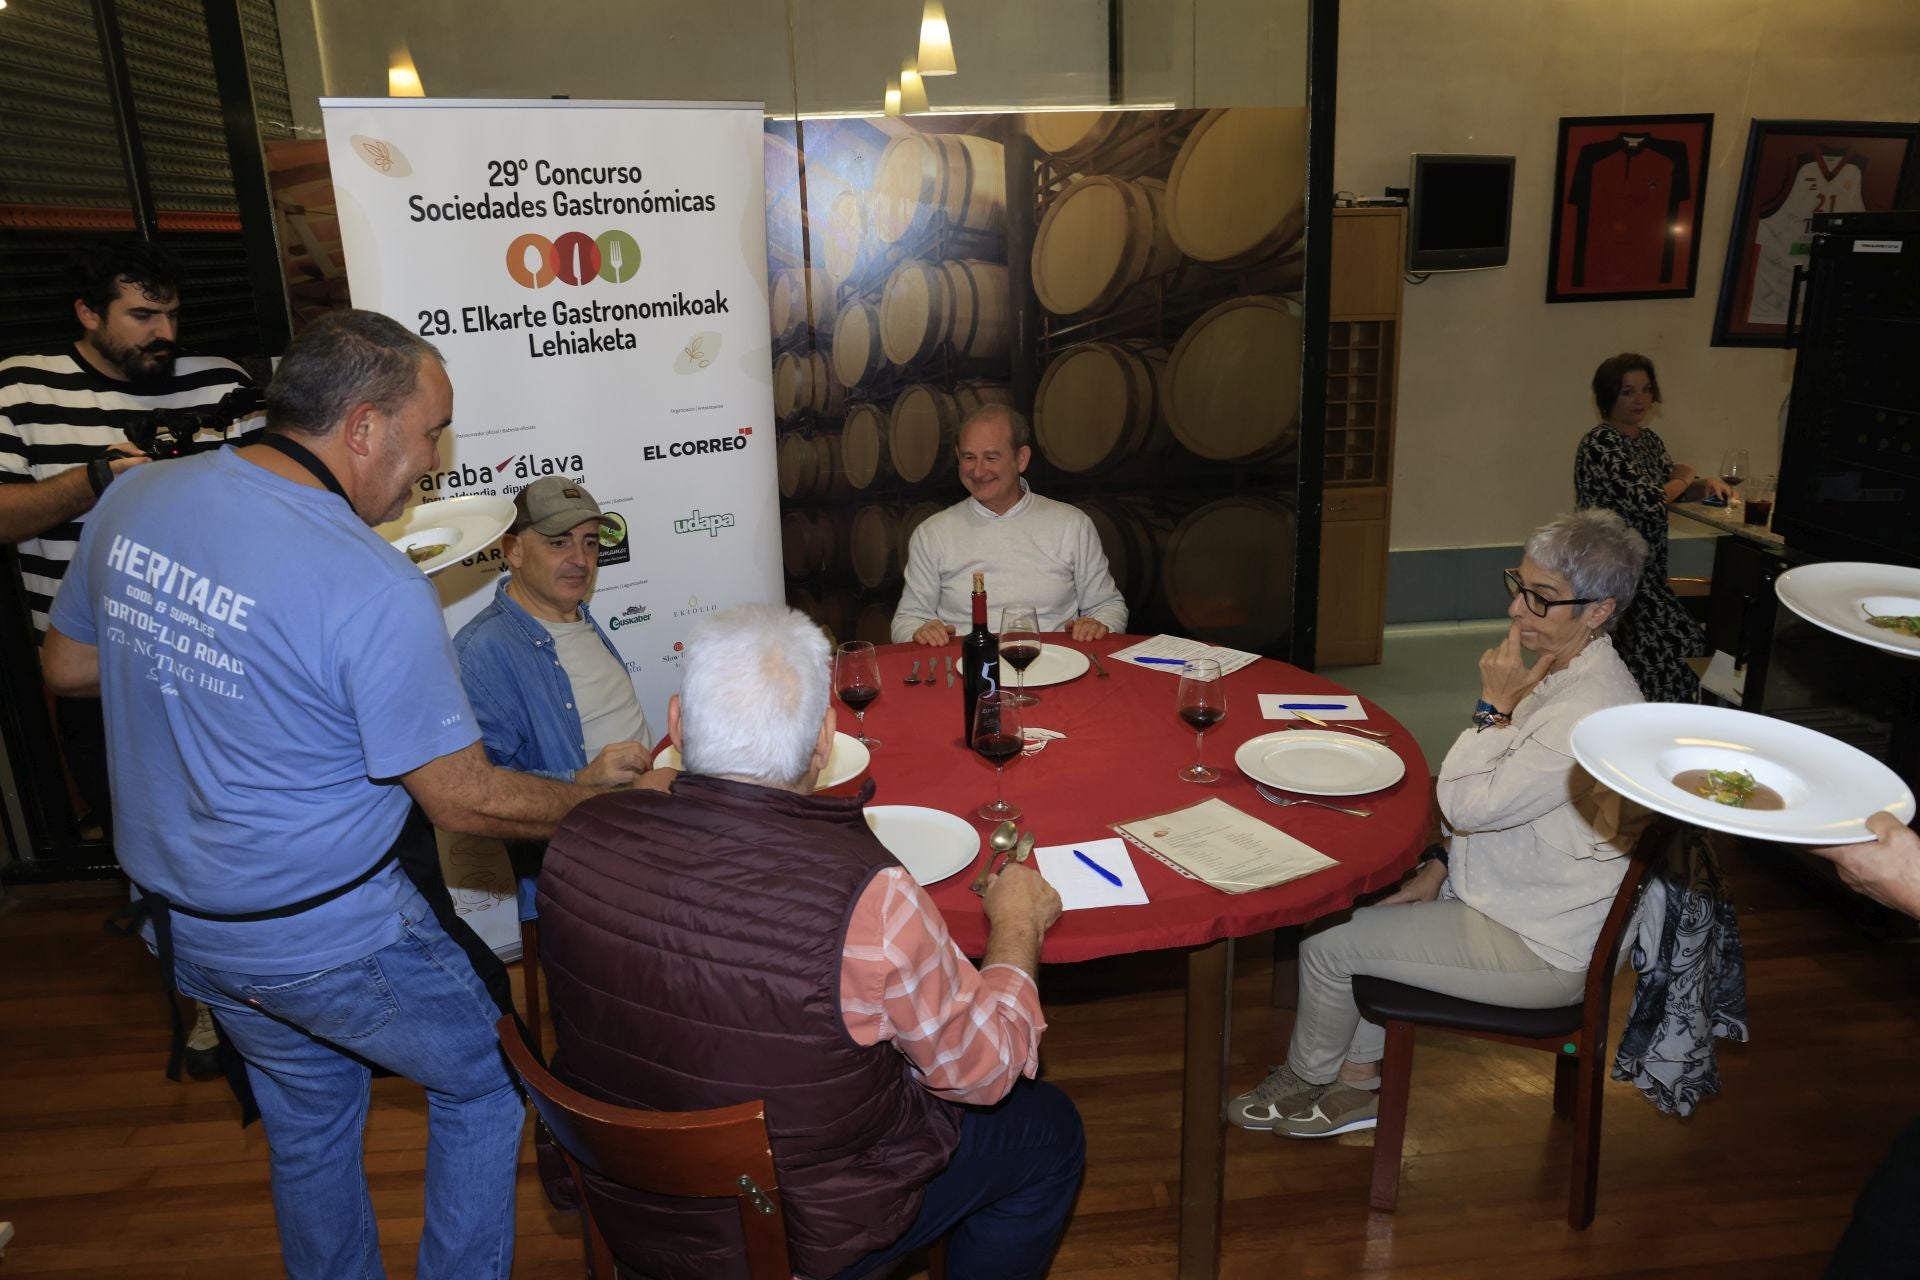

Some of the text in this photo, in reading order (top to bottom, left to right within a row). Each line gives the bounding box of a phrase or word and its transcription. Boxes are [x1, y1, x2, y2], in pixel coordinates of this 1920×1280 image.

[487, 158, 642, 187] 29º Concurso
[408, 189, 716, 222] Sociedades Gastronómicas
[1813, 193, 1837, 212] 21
[417, 289, 729, 338] 29. Elkarte Gastronomikoak
[528, 326, 637, 358] Lehiaketa
[643, 435, 747, 461] EL CORREO
[419, 454, 583, 492] araba álava
[673, 509, 735, 537] udapa
[462, 548, 507, 567] GAR
[107, 534, 256, 632] HERITAGE
[155, 600, 168, 614] &
[169, 606, 215, 639] SUPPLIES
[194, 642, 245, 676] ROAD
[199, 672, 244, 700] HILL
[981, 660, 998, 699] 5
